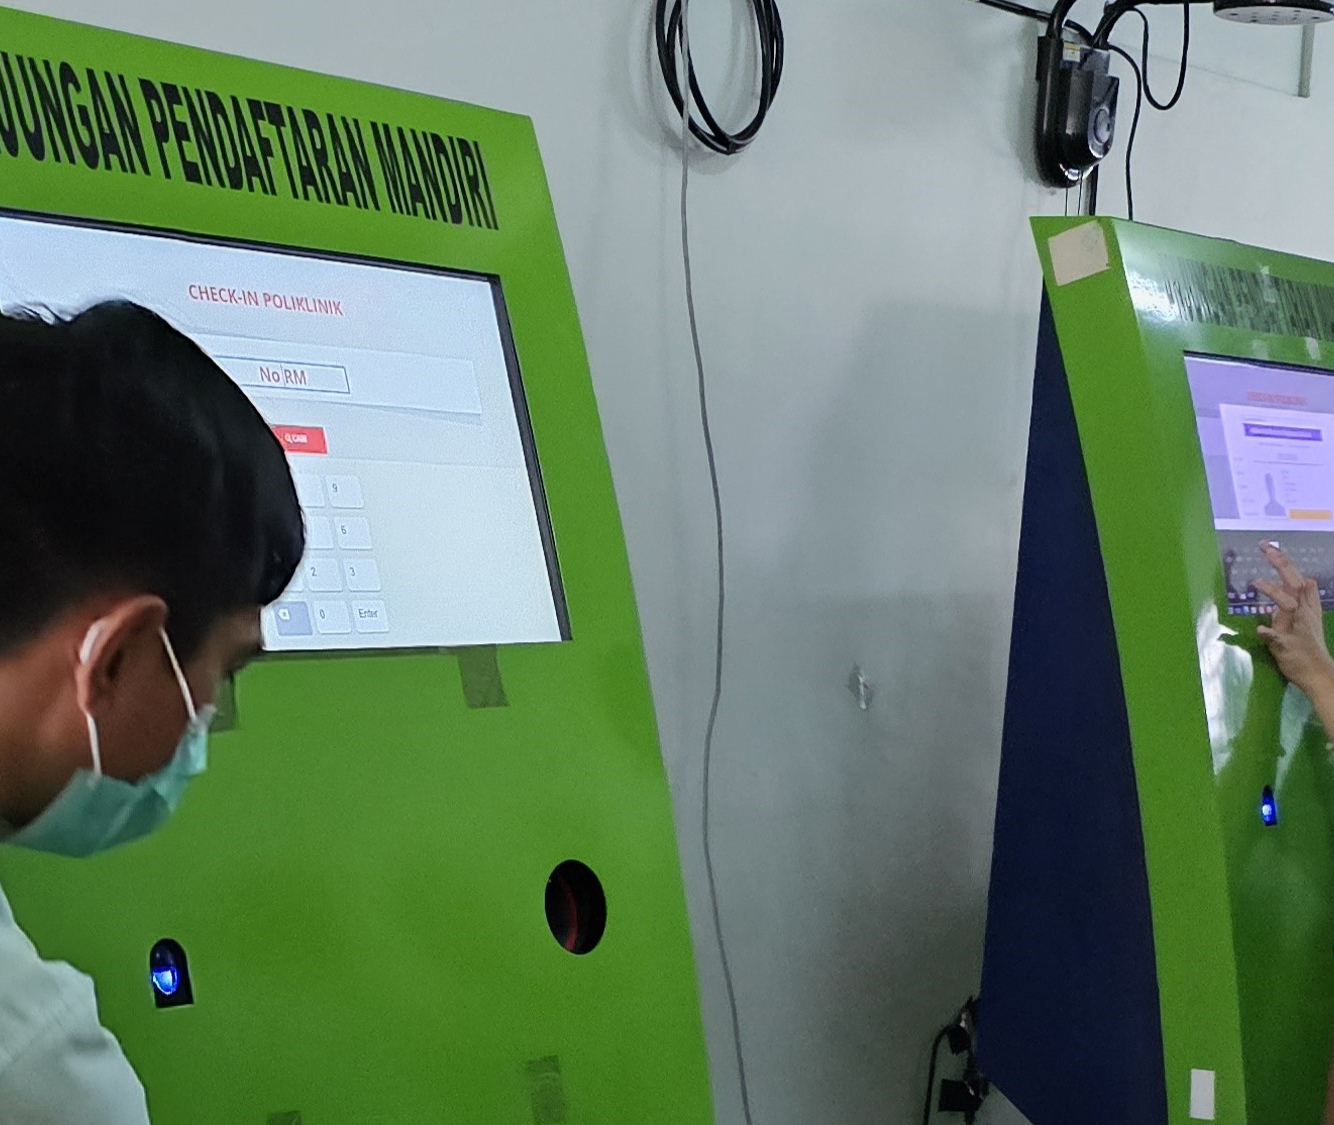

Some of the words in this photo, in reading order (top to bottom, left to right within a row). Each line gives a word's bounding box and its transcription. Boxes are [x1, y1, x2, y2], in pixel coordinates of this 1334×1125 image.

[137, 77, 381, 213] PENDAFTARAN
[369, 120, 499, 231] MANDIRI
[188, 284, 260, 307] CHECK-IN
[262, 292, 344, 317] POLIKLINIK
[259, 366, 281, 383] No
[284, 368, 307, 385] RM
[331, 483, 338, 493] 9
[340, 525, 347, 535] 6
[310, 567, 317, 577] 2
[349, 567, 356, 577] 3
[358, 608, 378, 619] Enter
